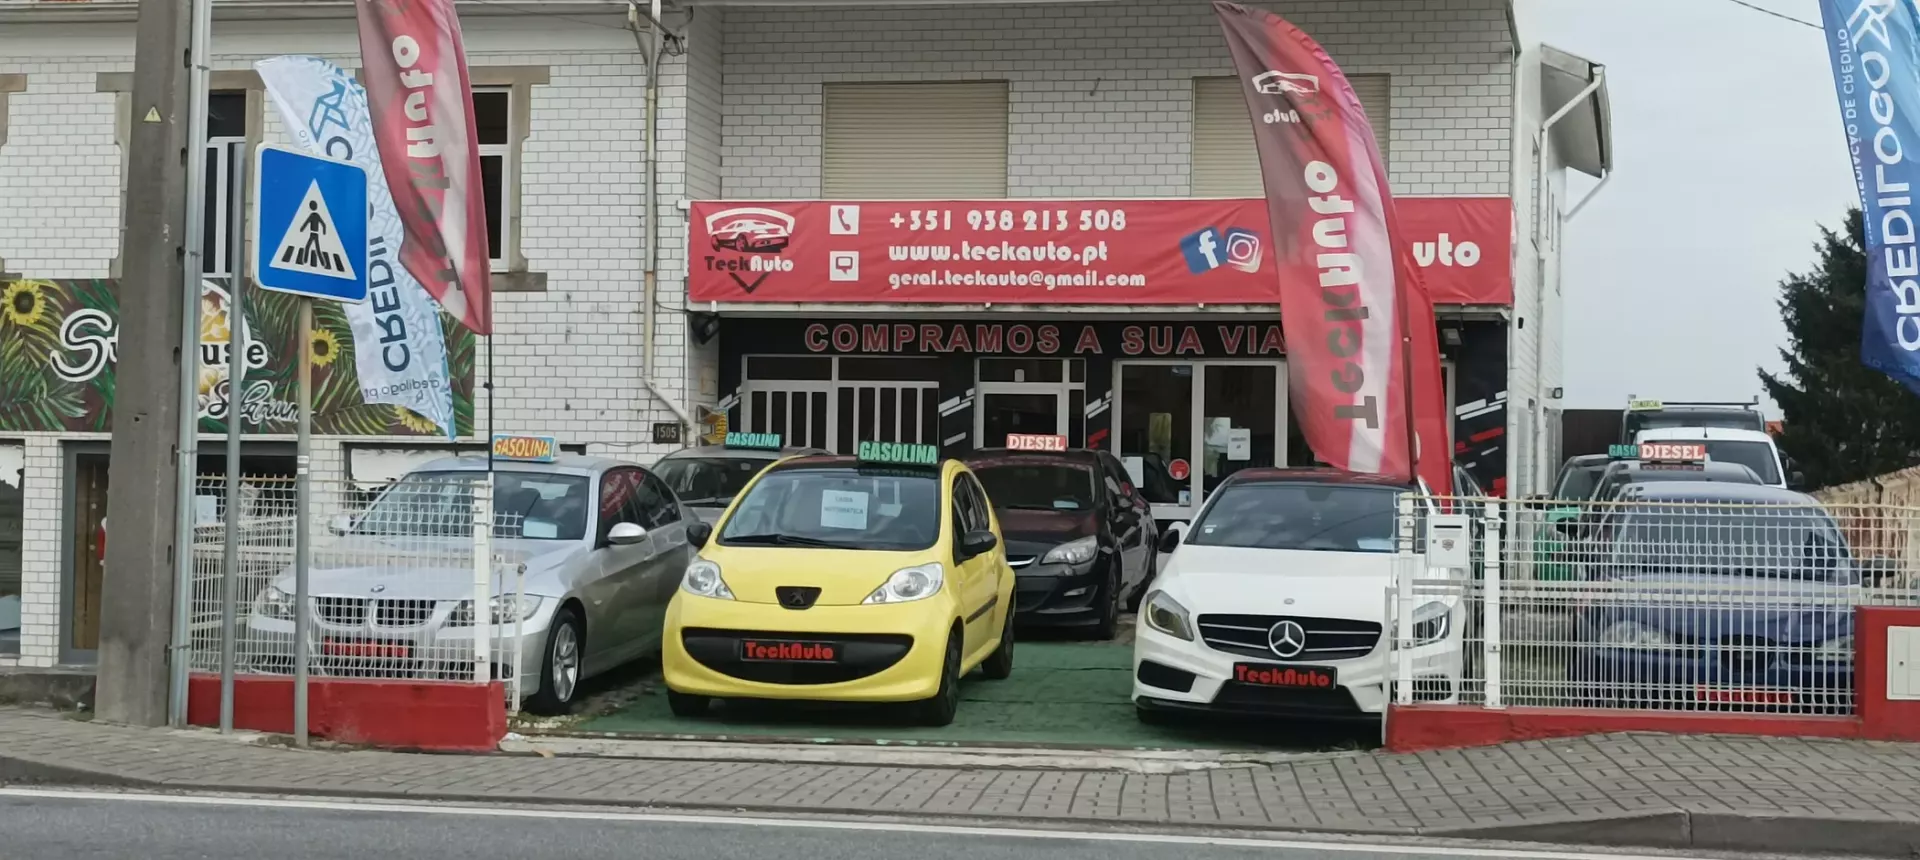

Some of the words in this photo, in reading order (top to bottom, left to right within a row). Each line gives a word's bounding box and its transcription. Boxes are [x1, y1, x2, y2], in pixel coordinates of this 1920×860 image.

[889, 210, 952, 231] +351
[967, 209, 1014, 231] 938
[1022, 209, 1069, 231] 213
[1079, 209, 1127, 231] 508
[889, 240, 1108, 266] www.teckauto.pt
[1412, 232, 1481, 267] uto
[704, 255, 794, 272] TeckAuto
[889, 270, 1146, 290] geral.teckauto@gmail.com
[804, 323, 1061, 354] COMPRAMOS
[1074, 325, 1103, 354] A
[1121, 325, 1205, 355] SUA
[1218, 325, 1287, 355] VIA
[655, 425, 677, 439] 1505
[725, 432, 780, 447] GASOLINA
[493, 436, 550, 458] GASOLINA
[860, 441, 937, 464] GASOLINA
[1006, 435, 1066, 452] DIESEL
[1608, 444, 1637, 457] GASO
[1641, 445, 1704, 459] DIESEL
[745, 642, 834, 660] TeckAuto
[1235, 665, 1330, 687] TeckAuto
